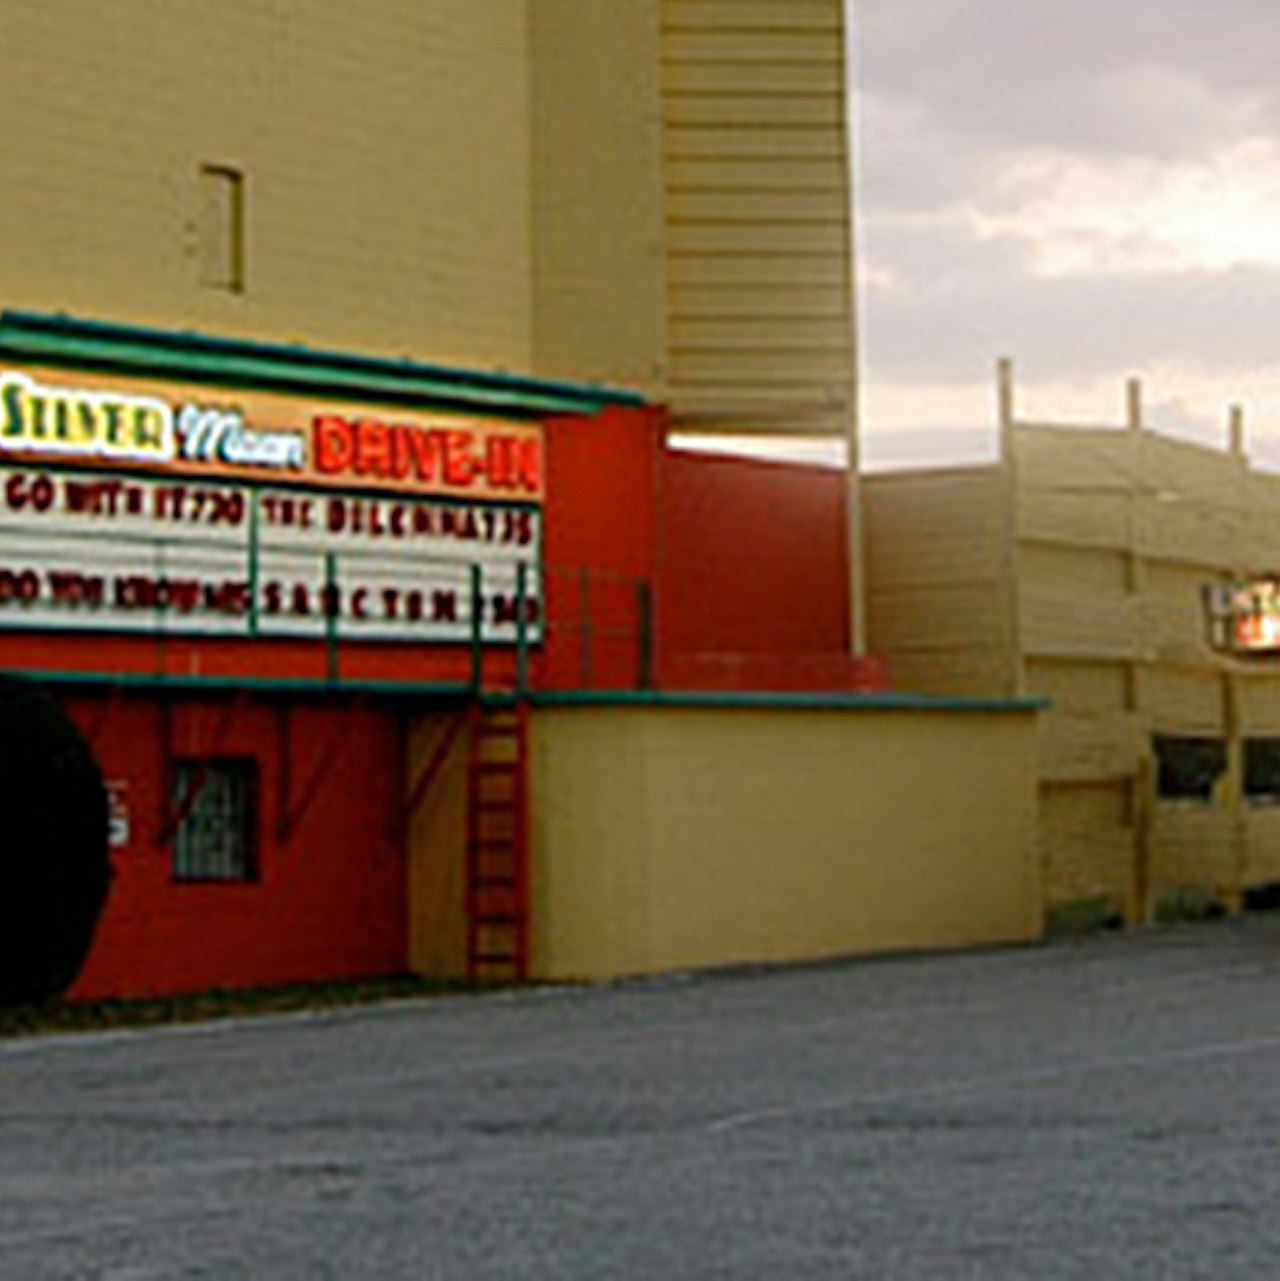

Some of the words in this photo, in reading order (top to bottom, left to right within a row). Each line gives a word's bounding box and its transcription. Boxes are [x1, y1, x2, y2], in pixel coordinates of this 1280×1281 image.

[177, 400, 305, 468] Moon
[313, 413, 538, 493] DRIVE-IN
[5, 473, 54, 511] GO
